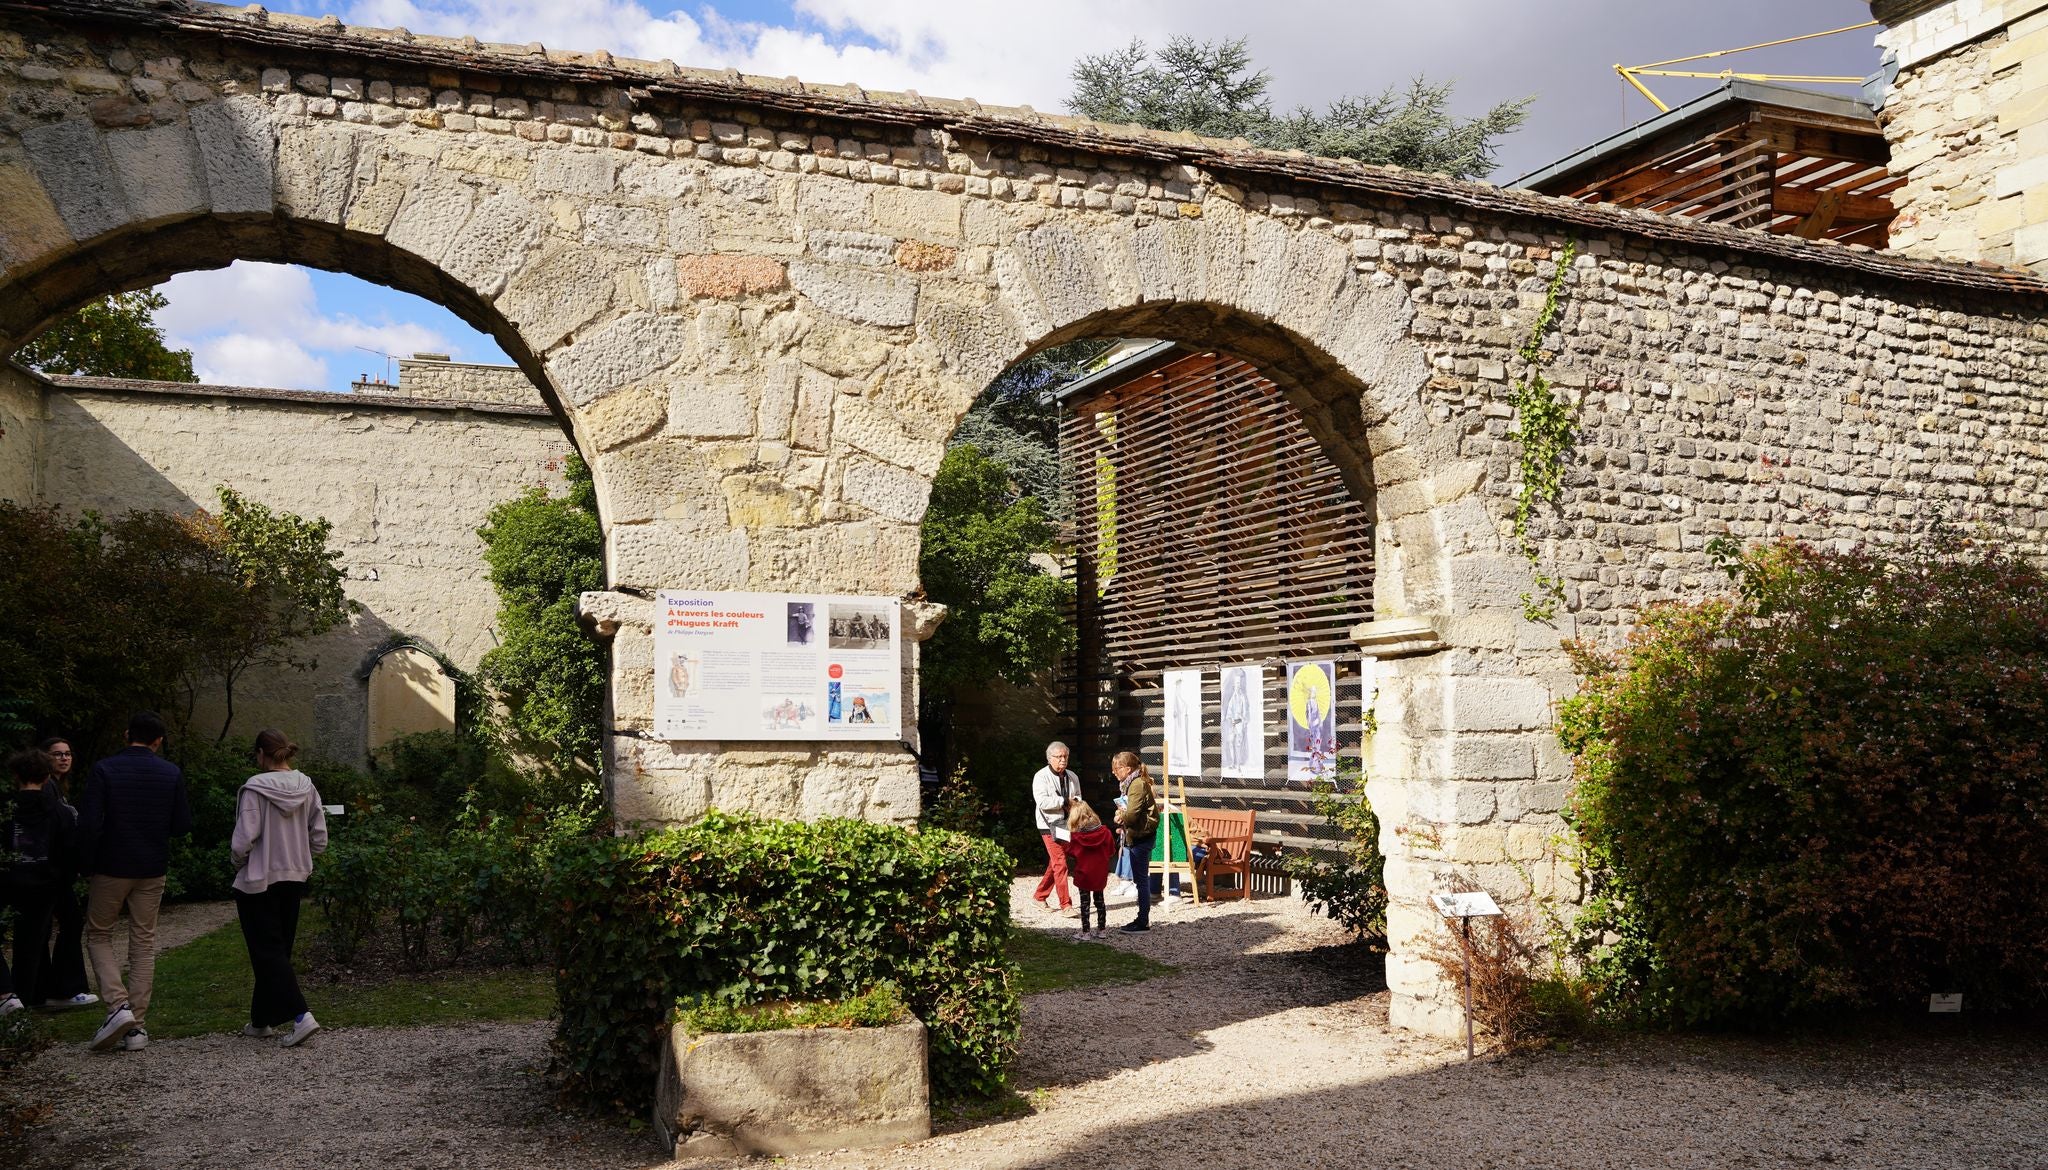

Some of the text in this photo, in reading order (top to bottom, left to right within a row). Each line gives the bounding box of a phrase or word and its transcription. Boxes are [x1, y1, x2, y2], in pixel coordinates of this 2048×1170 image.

[668, 599, 714, 607] Exposition
[668, 608, 675, 616] À
[677, 609, 709, 617] travers
[711, 610, 724, 618] les
[668, 619, 739, 628] d'Hugues Krafft
